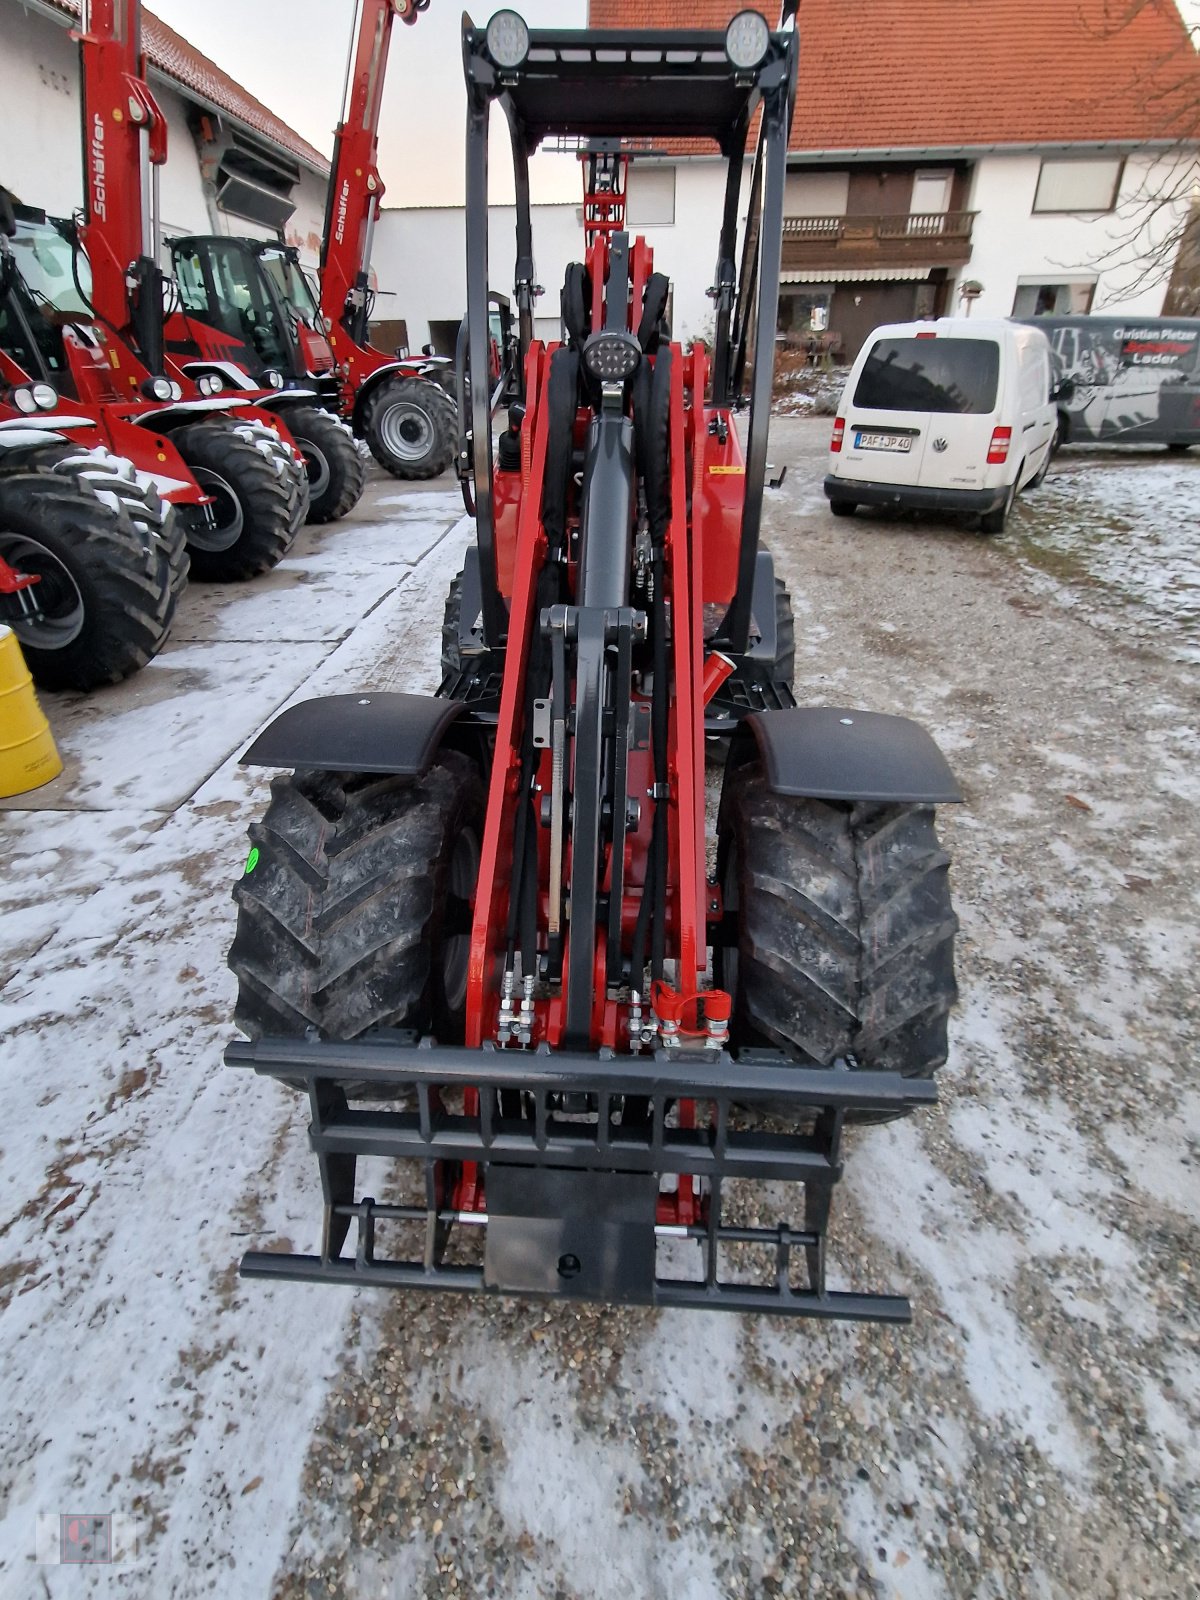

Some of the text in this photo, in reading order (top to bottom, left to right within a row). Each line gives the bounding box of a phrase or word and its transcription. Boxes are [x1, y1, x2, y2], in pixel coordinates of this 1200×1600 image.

[92, 113, 106, 222] Schäffer
[335, 179, 349, 245] Schäffer
[1112, 327, 1161, 340] Christian
[861, 434, 911, 449] PAF JP 40
